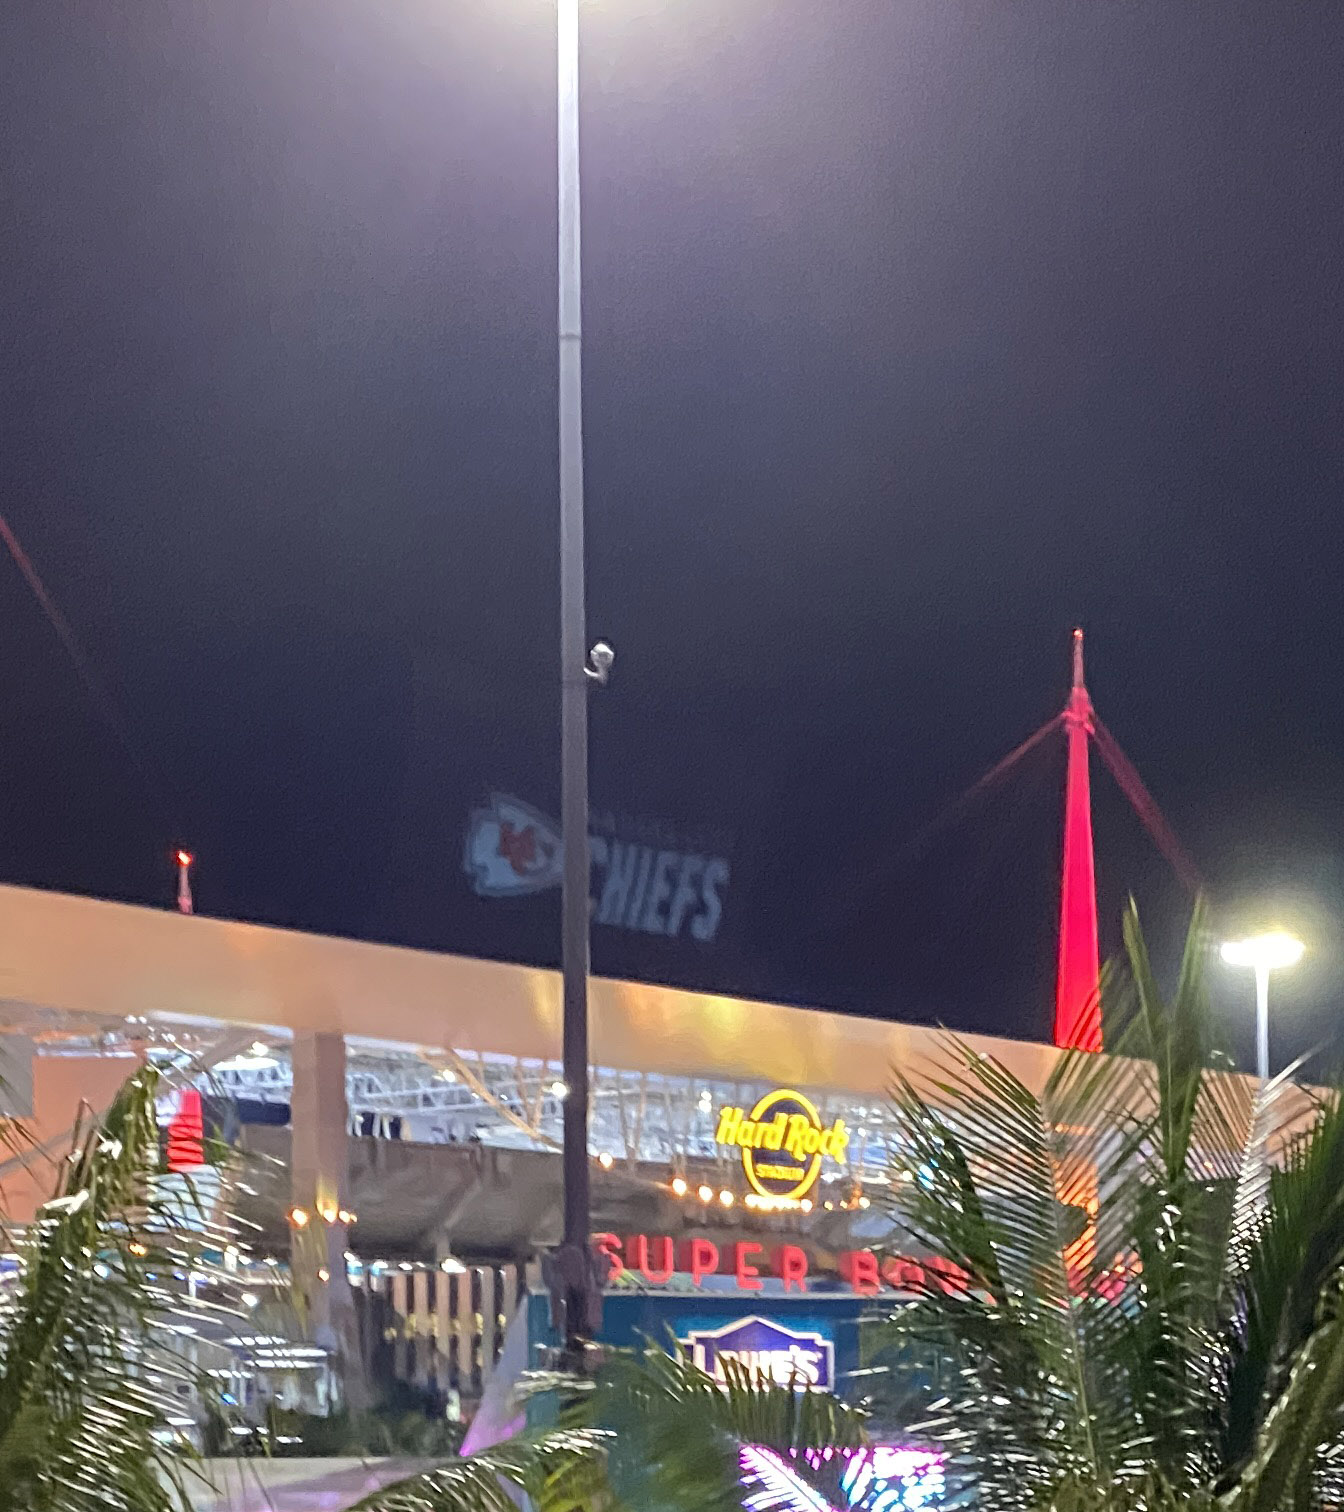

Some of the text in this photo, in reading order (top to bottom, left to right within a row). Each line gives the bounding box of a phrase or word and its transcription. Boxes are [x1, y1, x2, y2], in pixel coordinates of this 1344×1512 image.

[716, 1106, 849, 1164] Hard Rock
[592, 1232, 808, 1293] SUPER
